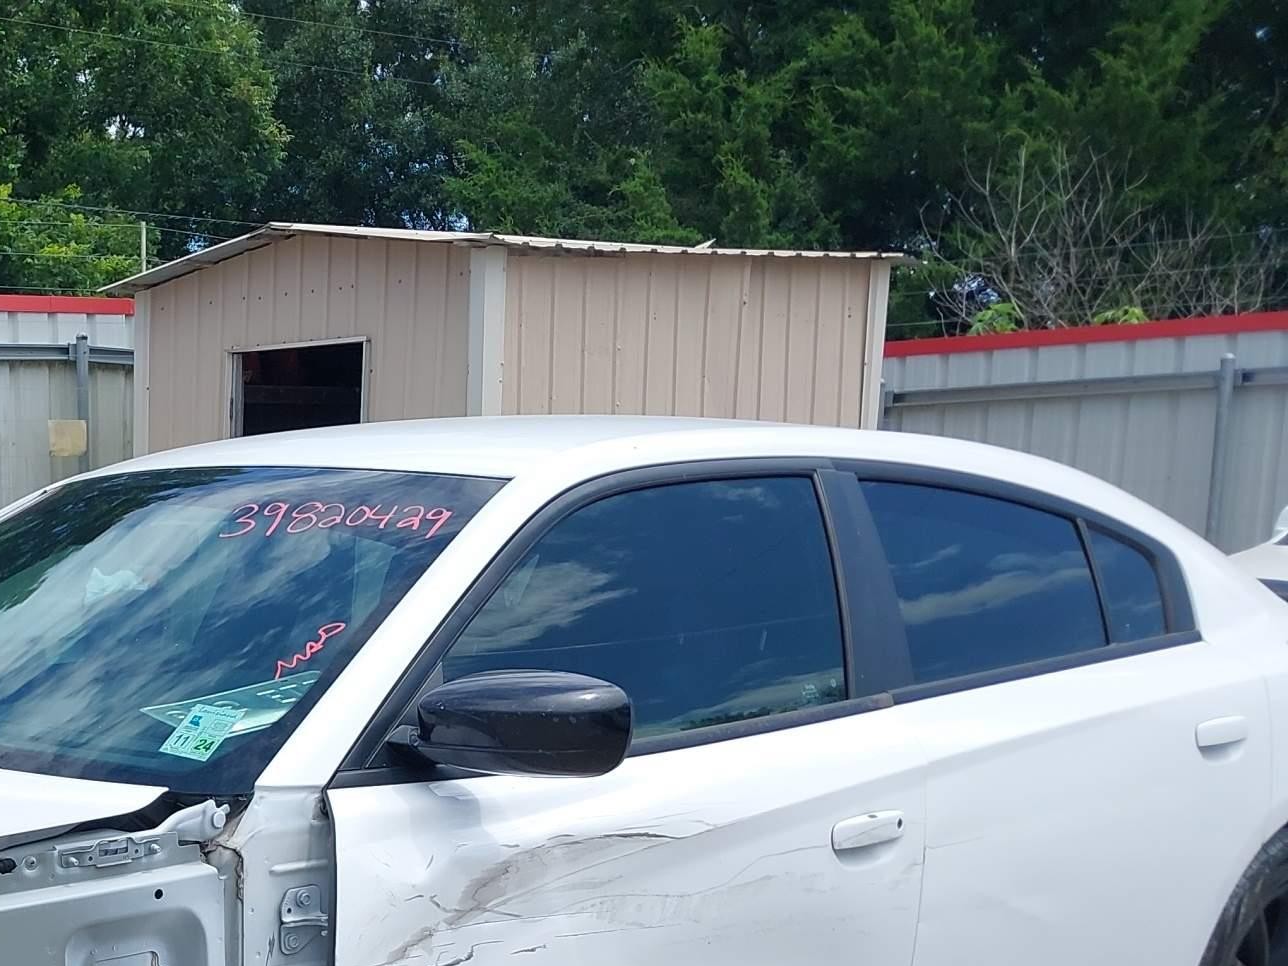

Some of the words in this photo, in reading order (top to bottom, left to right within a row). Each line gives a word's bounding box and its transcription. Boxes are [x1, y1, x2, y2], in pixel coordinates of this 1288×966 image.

[218, 501, 453, 539] 39820429
[173, 734, 190, 748] 11
[193, 738, 215, 753] 24
